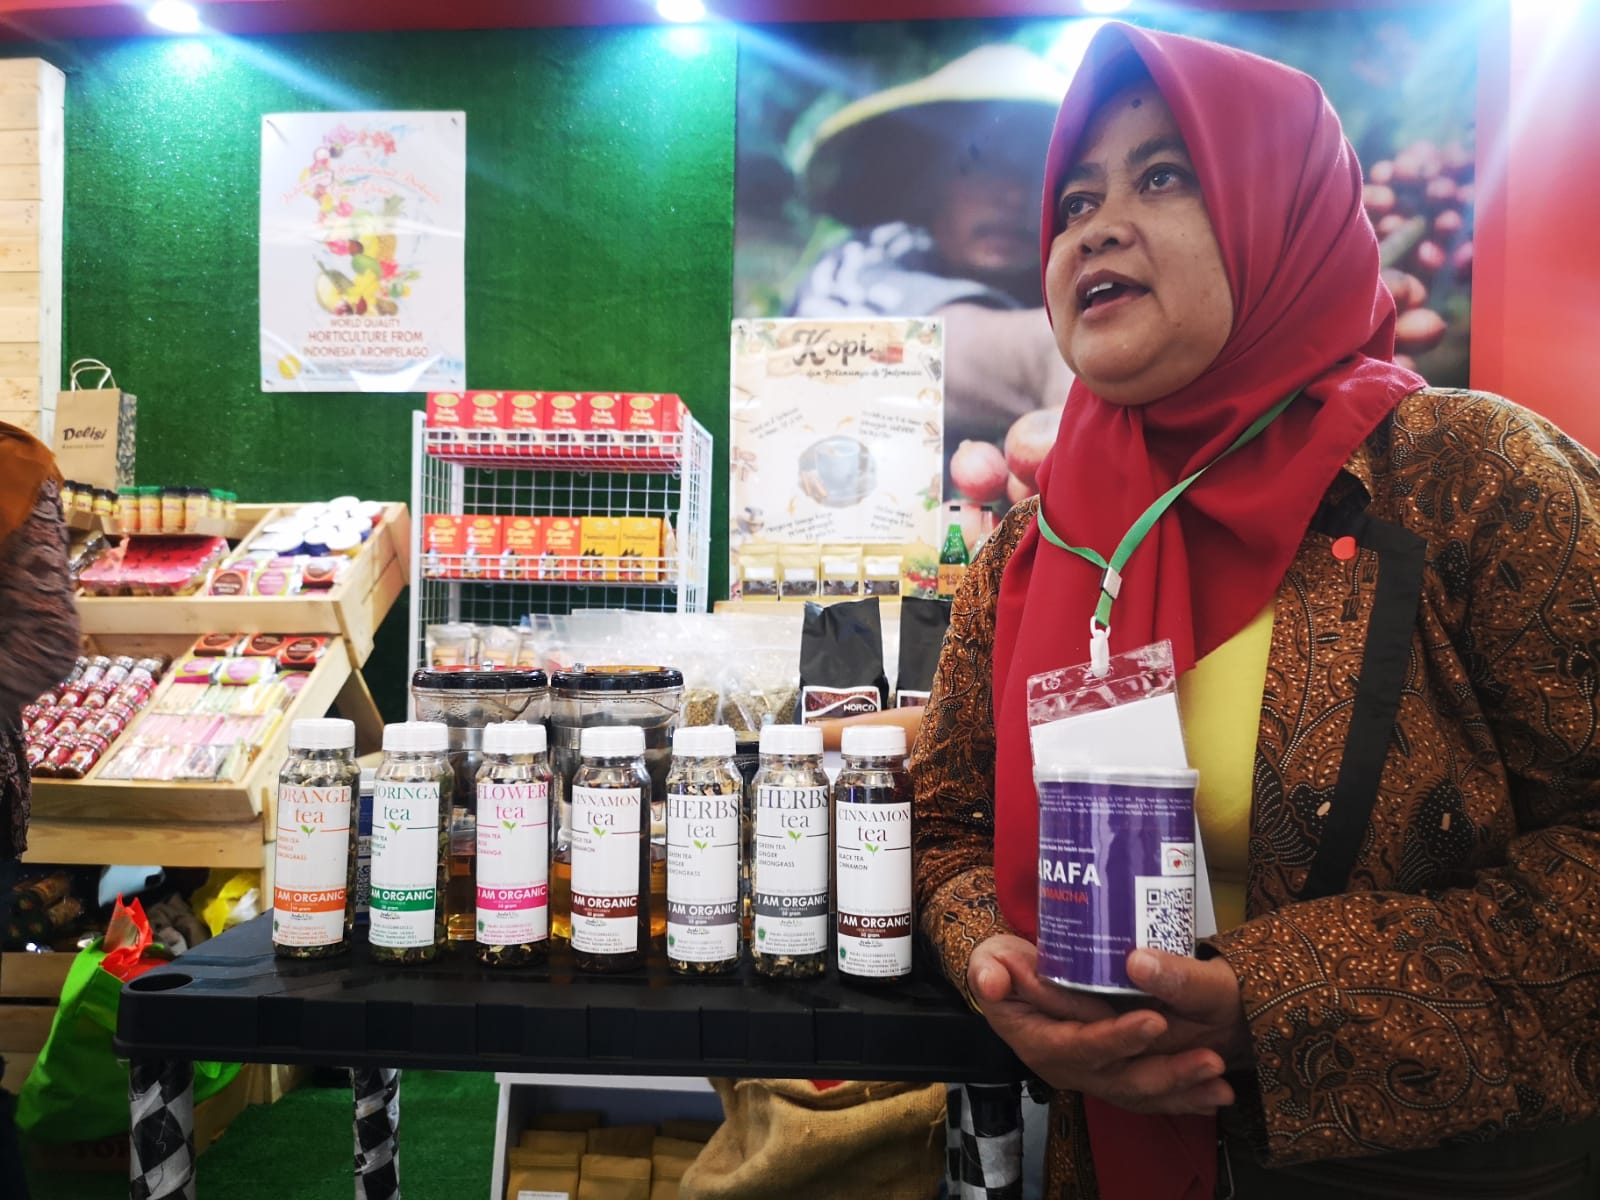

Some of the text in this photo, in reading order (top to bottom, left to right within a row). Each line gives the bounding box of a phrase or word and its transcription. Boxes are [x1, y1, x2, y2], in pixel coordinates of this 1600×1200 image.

[308, 331, 423, 342] HORTICULTURE FROM
[303, 347, 429, 358] INDONESIA ARCHIPELAGO
[792, 328, 874, 367] Kopi
[63, 426, 107, 441] Delisi
[280, 788, 350, 805] ORANGE
[375, 784, 440, 800] ORINGA
[478, 784, 547, 801] FLOWER
[759, 788, 828, 809] HERBS
[384, 806, 411, 821] tea
[496, 805, 524, 820] tea
[668, 798, 738, 819] HERBS
[838, 808, 909, 823] CINNAMON
[295, 809, 325, 824] tea
[588, 811, 615, 826] tea
[780, 814, 810, 829] tea
[687, 823, 716, 838] tea
[858, 826, 887, 842] tea
[278, 890, 291, 901] AM
[293, 890, 346, 903] ORGANIC
[371, 888, 434, 902] AM ORGANIC
[481, 890, 495, 900] AM
[498, 886, 547, 901] ORGANIC
[762, 895, 779, 907] AM
[782, 893, 828, 908] ORGANIC
[574, 895, 585, 906] AM
[587, 896, 637, 909] ORGANIC
[672, 905, 686, 915] AM
[689, 903, 737, 916] ORGANIC
[843, 916, 858, 928] AM
[860, 915, 911, 929] ORGANIC
